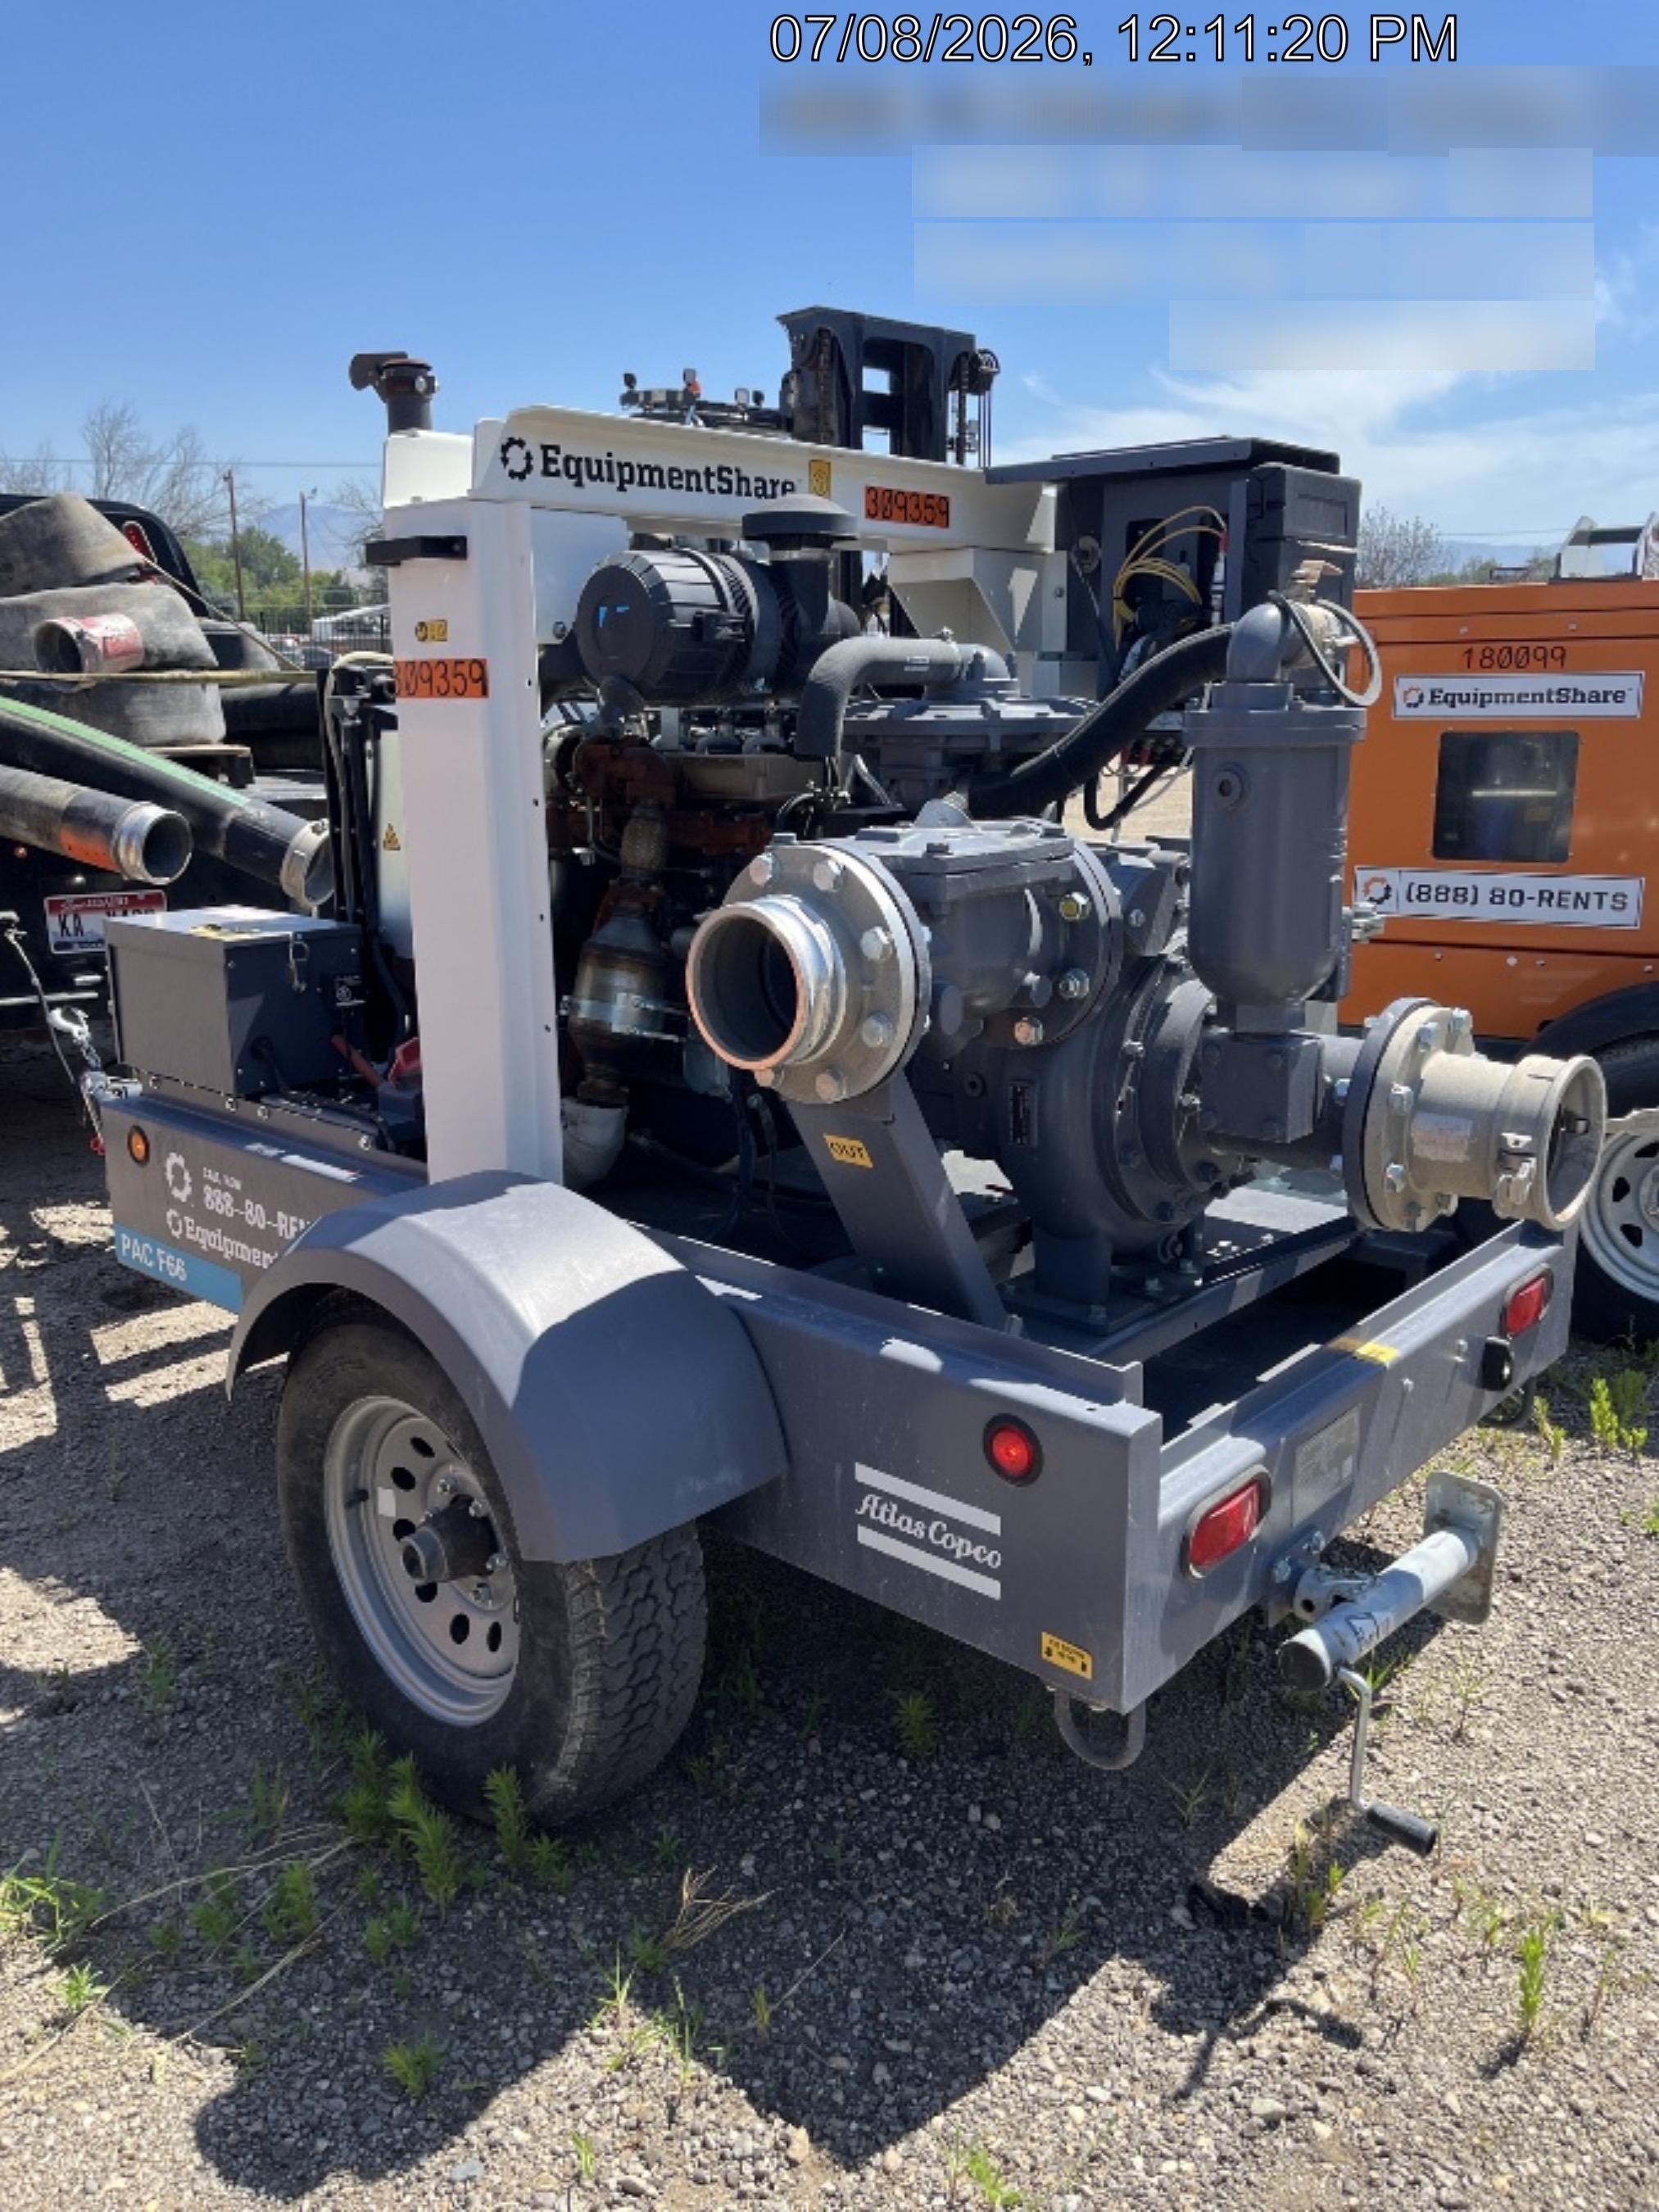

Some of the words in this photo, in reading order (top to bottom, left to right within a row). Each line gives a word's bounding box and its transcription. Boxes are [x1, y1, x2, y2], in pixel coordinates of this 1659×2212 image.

[541, 444, 796, 500] EquipmentShare
[866, 486, 950, 528] 309359
[1463, 646, 1567, 669] 180099
[1428, 687, 1627, 709] EquipmentShare
[1406, 882, 1478, 906] (888)
[1489, 887, 1629, 911] 80-RENTS
[120, 1232, 154, 1267] PAC
[156, 1248, 188, 1282] F66
[184, 1217, 279, 1269] Equipmen
[854, 1494, 926, 1539] Atlas
[928, 1520, 1002, 1569] Copco
